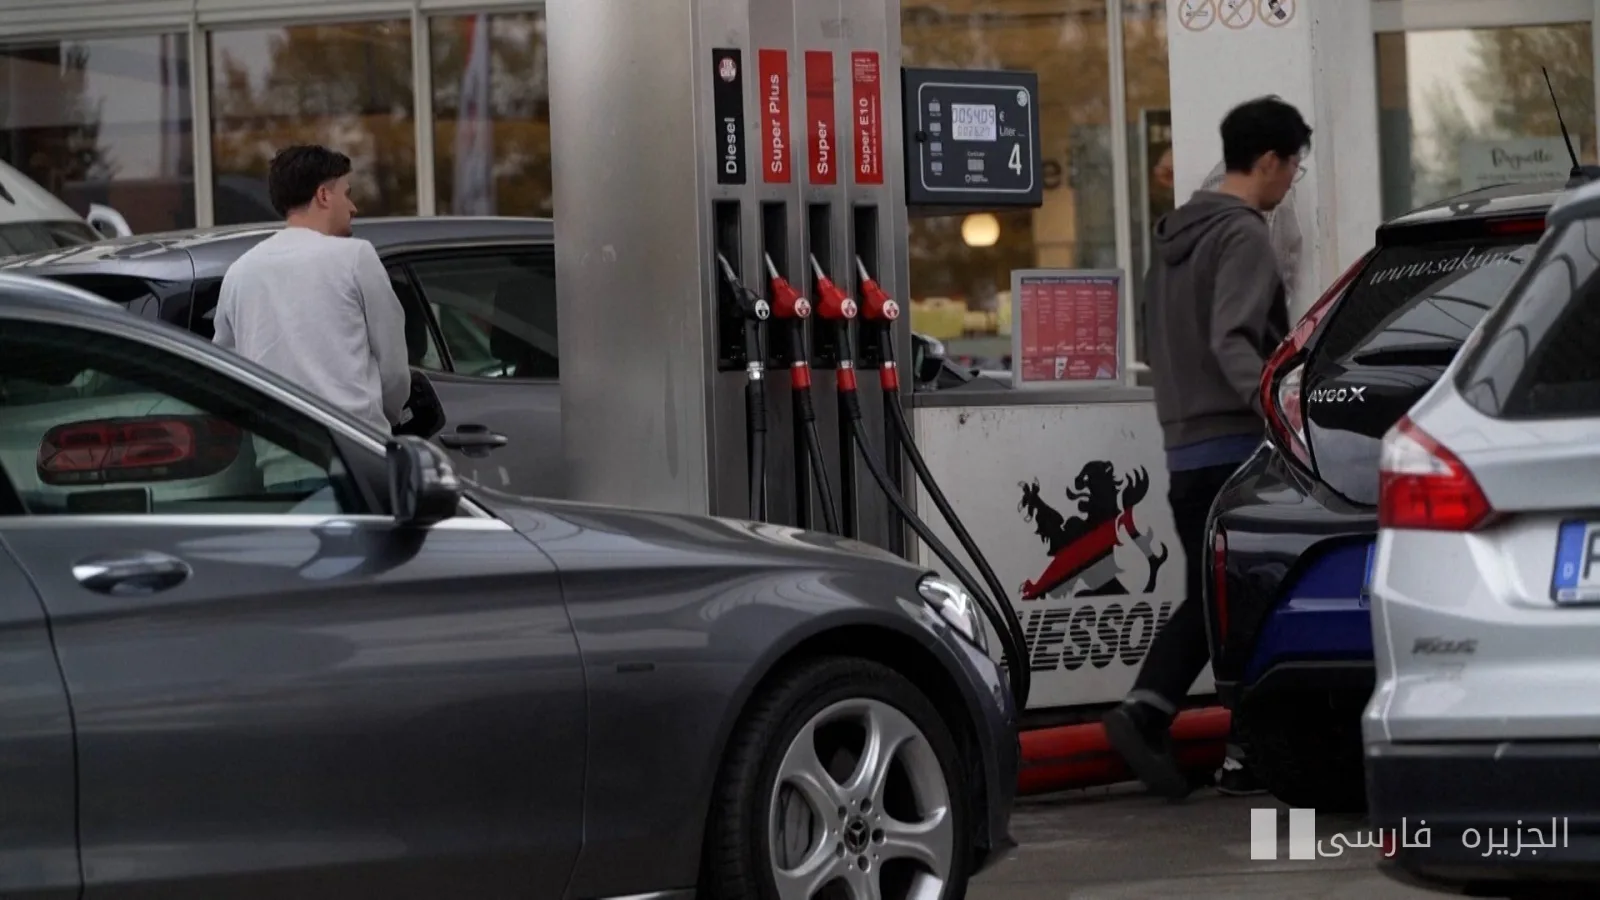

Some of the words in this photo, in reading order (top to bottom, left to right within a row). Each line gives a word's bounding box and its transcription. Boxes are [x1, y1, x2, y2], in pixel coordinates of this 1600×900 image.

[769, 74, 780, 114] Plus
[859, 97, 869, 125] E10
[724, 117, 737, 174] Diesel
[771, 119, 784, 174] Super
[817, 121, 830, 174] Super
[861, 129, 874, 174] Super
[1008, 142, 1022, 175] 4
[1307, 388, 1347, 403] AYGO
